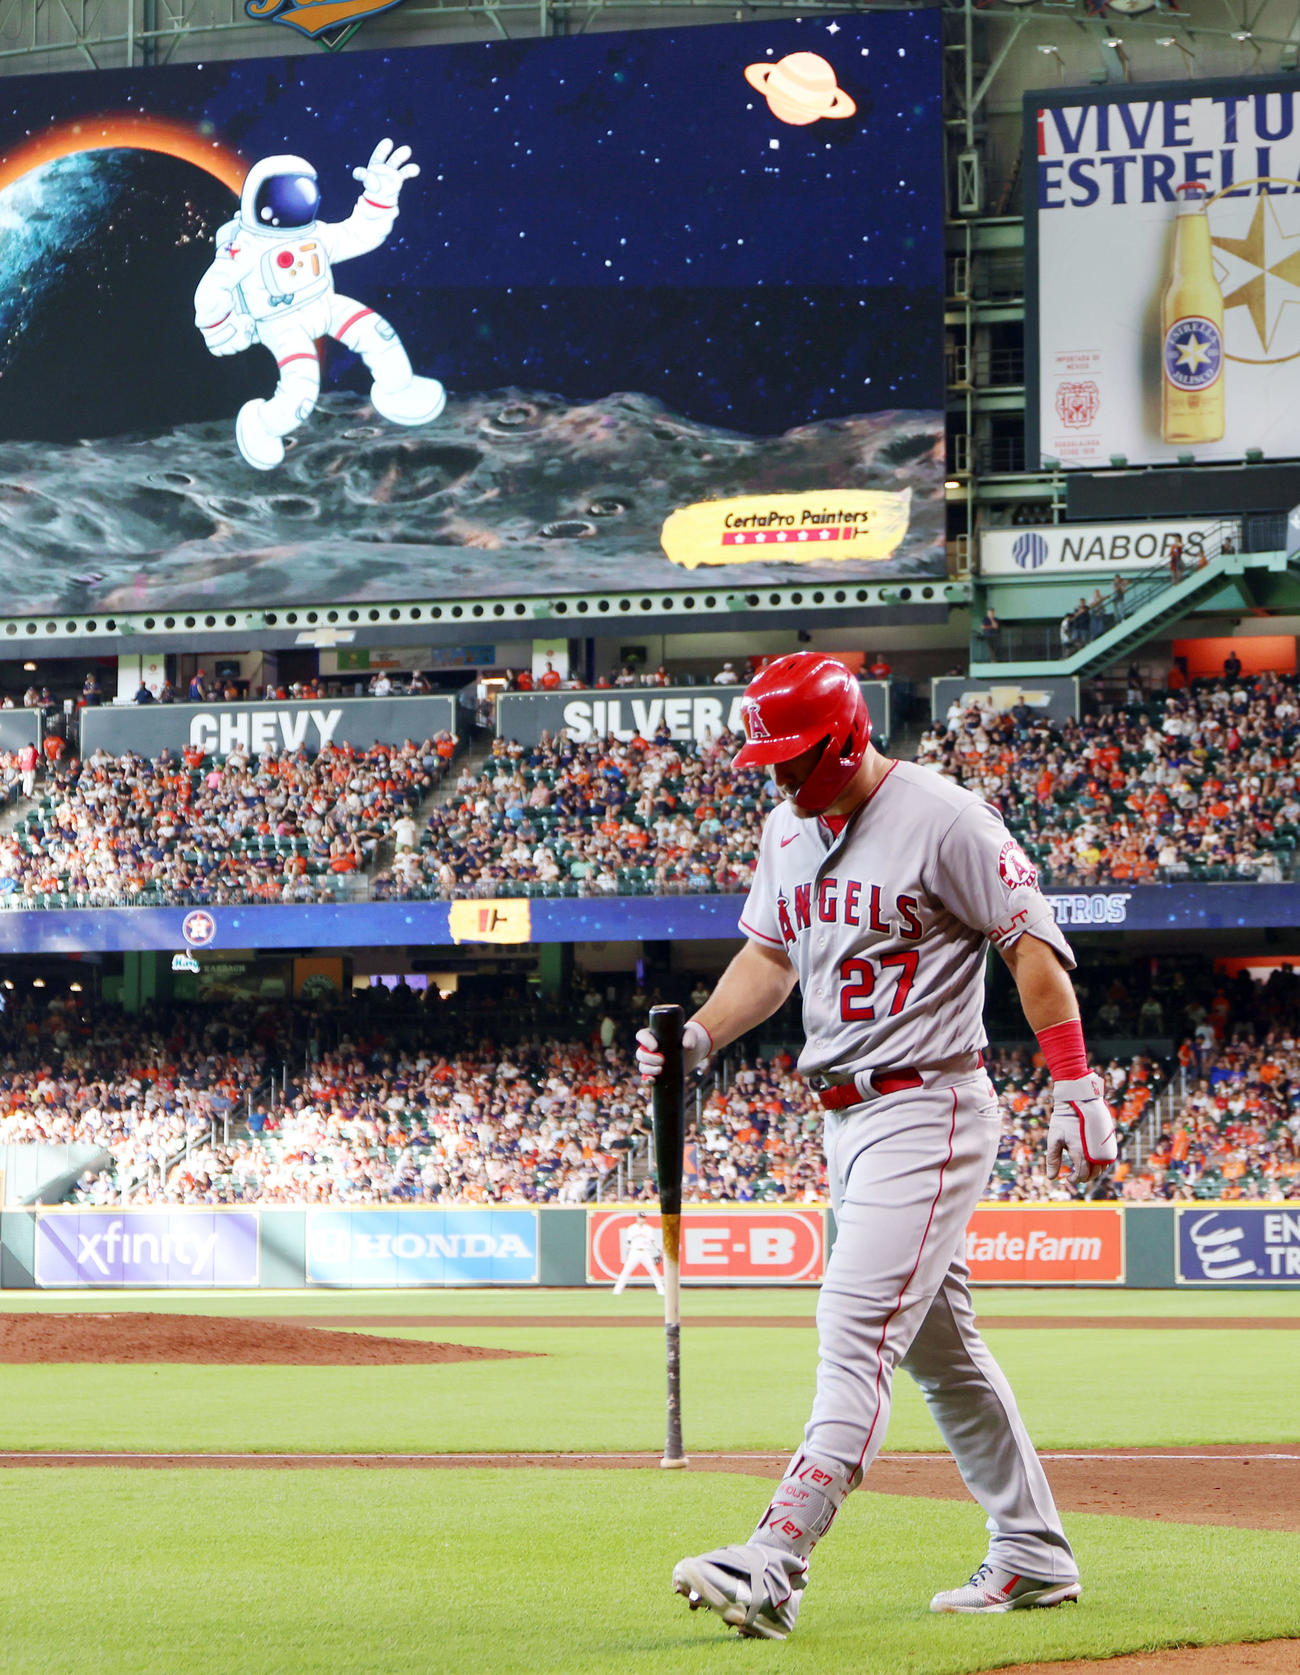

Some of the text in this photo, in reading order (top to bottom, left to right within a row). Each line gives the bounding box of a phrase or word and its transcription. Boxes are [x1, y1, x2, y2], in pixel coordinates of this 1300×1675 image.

[1212, 92, 1294, 144] TU
[1038, 146, 1300, 210] ESTRELL
[724, 507, 869, 529] CertaPro Painters
[189, 708, 344, 755] CHEVY
[775, 877, 923, 952] ANGELS
[1045, 893, 1132, 924] TROS
[839, 949, 920, 1023] 27
[76, 1221, 219, 1276] xfinity
[354, 1233, 534, 1259] HONDA
[964, 1231, 1102, 1262] tateFarm
[810, 1468, 833, 1487] 27
[781, 1520, 803, 1540] 27
